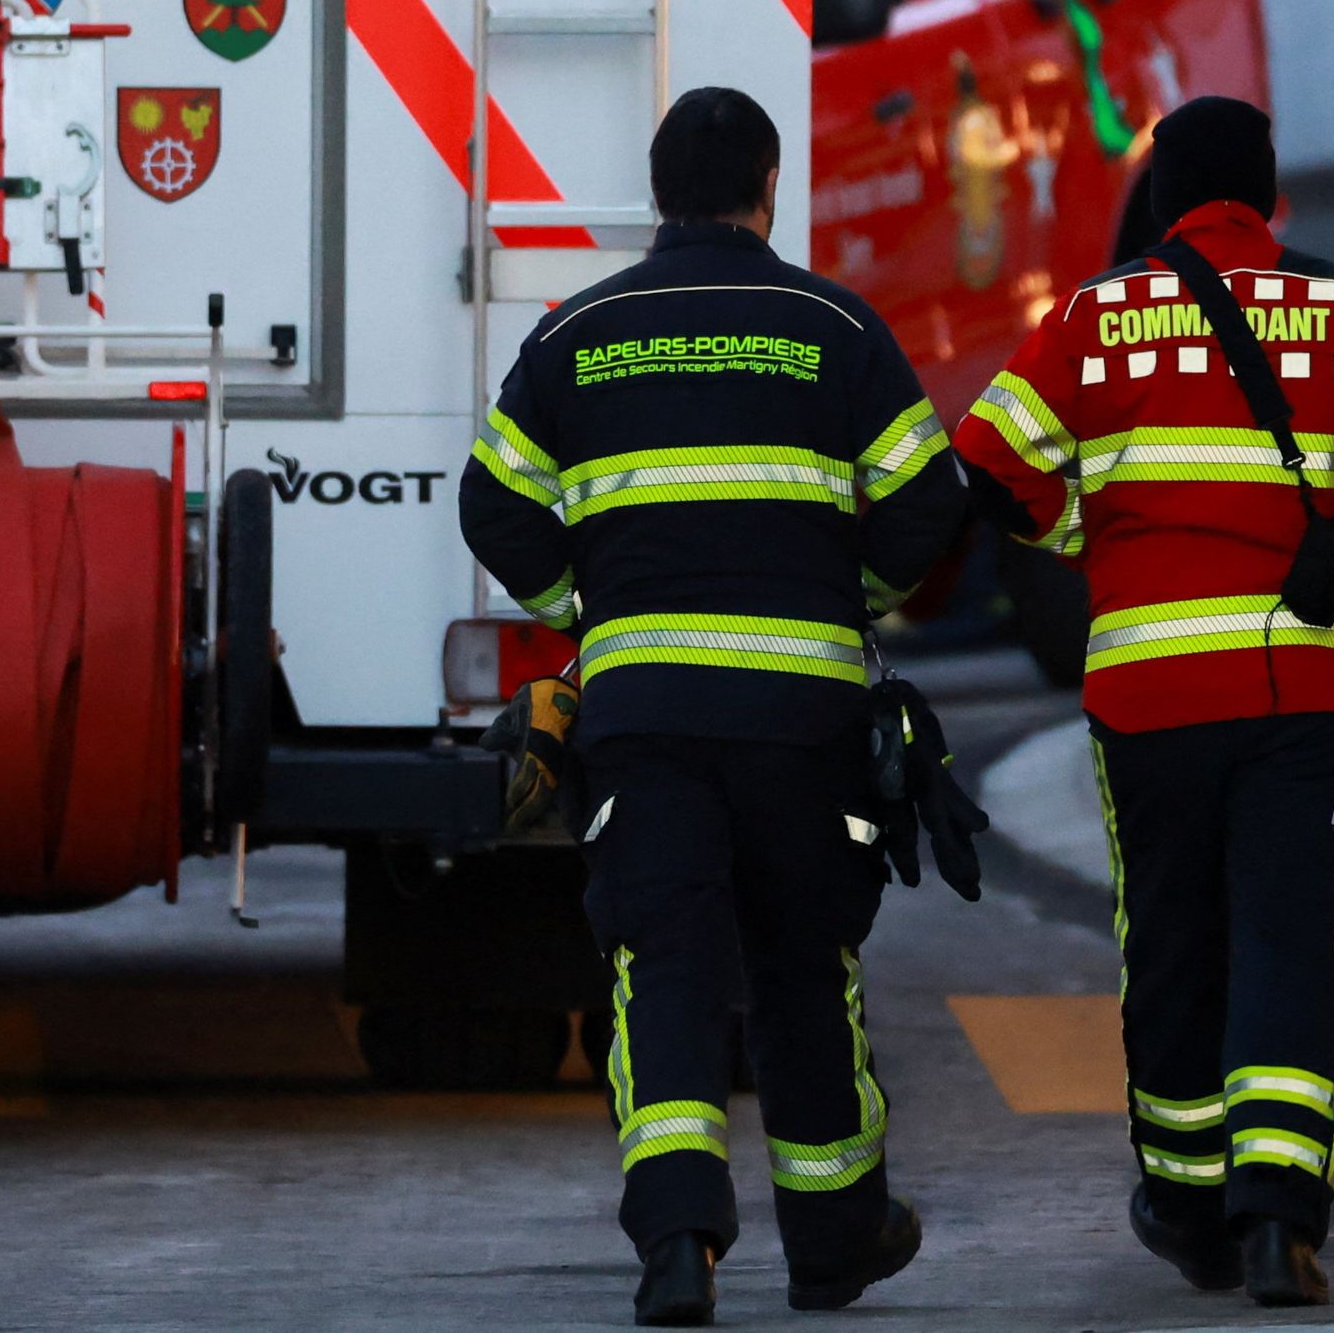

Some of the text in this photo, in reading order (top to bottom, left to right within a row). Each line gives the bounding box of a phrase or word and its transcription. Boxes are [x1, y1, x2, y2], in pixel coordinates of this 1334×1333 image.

[1098, 303, 1330, 347] COMMDANT
[575, 336, 821, 367] SAPEURS-POMPIERS
[576, 359, 818, 385] Centre de Secours Incendie Martigny Région
[269, 469, 446, 505] VOGT
